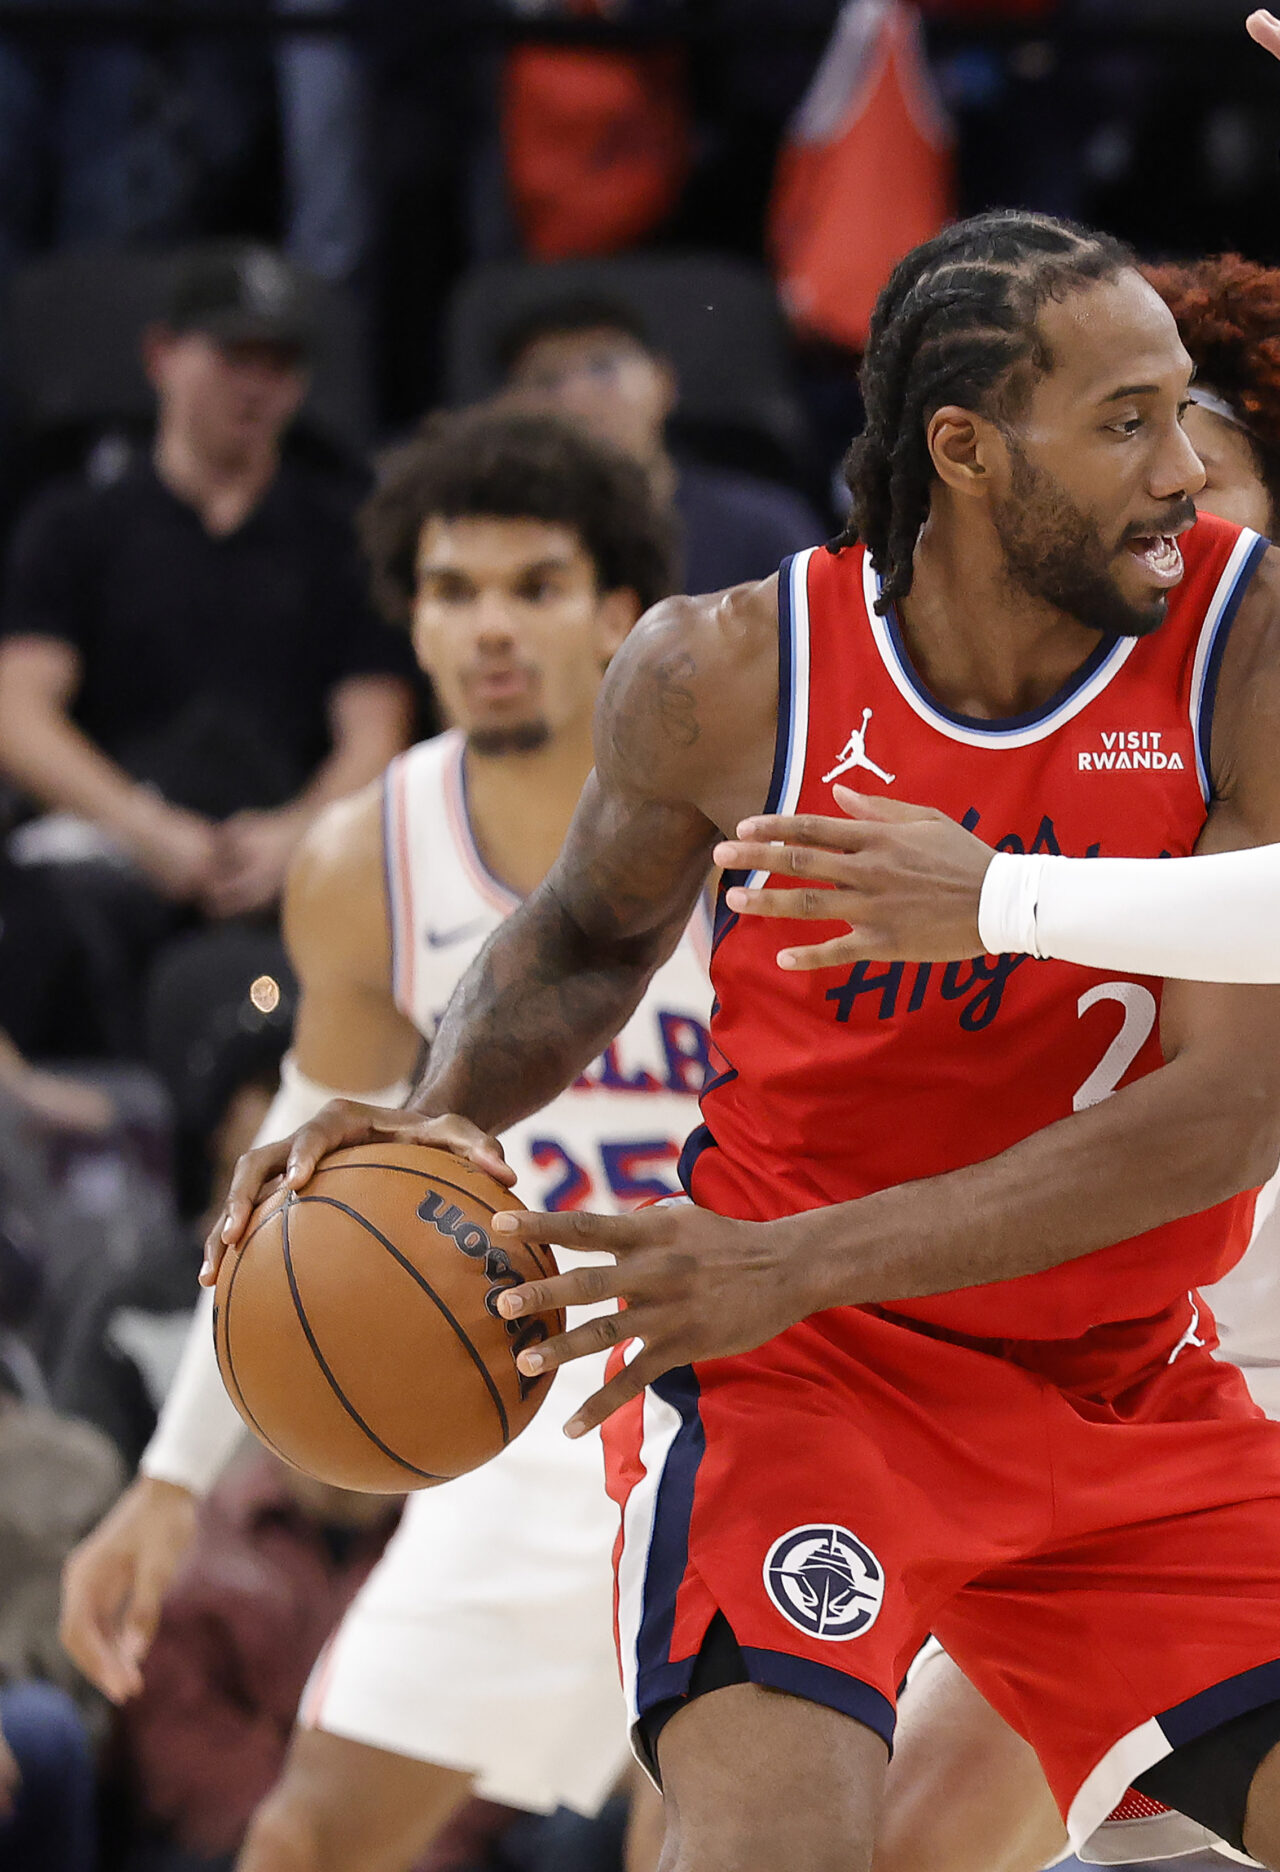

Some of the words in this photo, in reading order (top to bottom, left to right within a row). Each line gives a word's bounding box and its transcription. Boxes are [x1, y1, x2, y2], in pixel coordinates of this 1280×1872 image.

[1078, 751, 1185, 770] RWANDA
[1100, 731, 1162, 750] VISIT
[1072, 981, 1157, 1112] 2
[529, 1139, 682, 1212] 25
